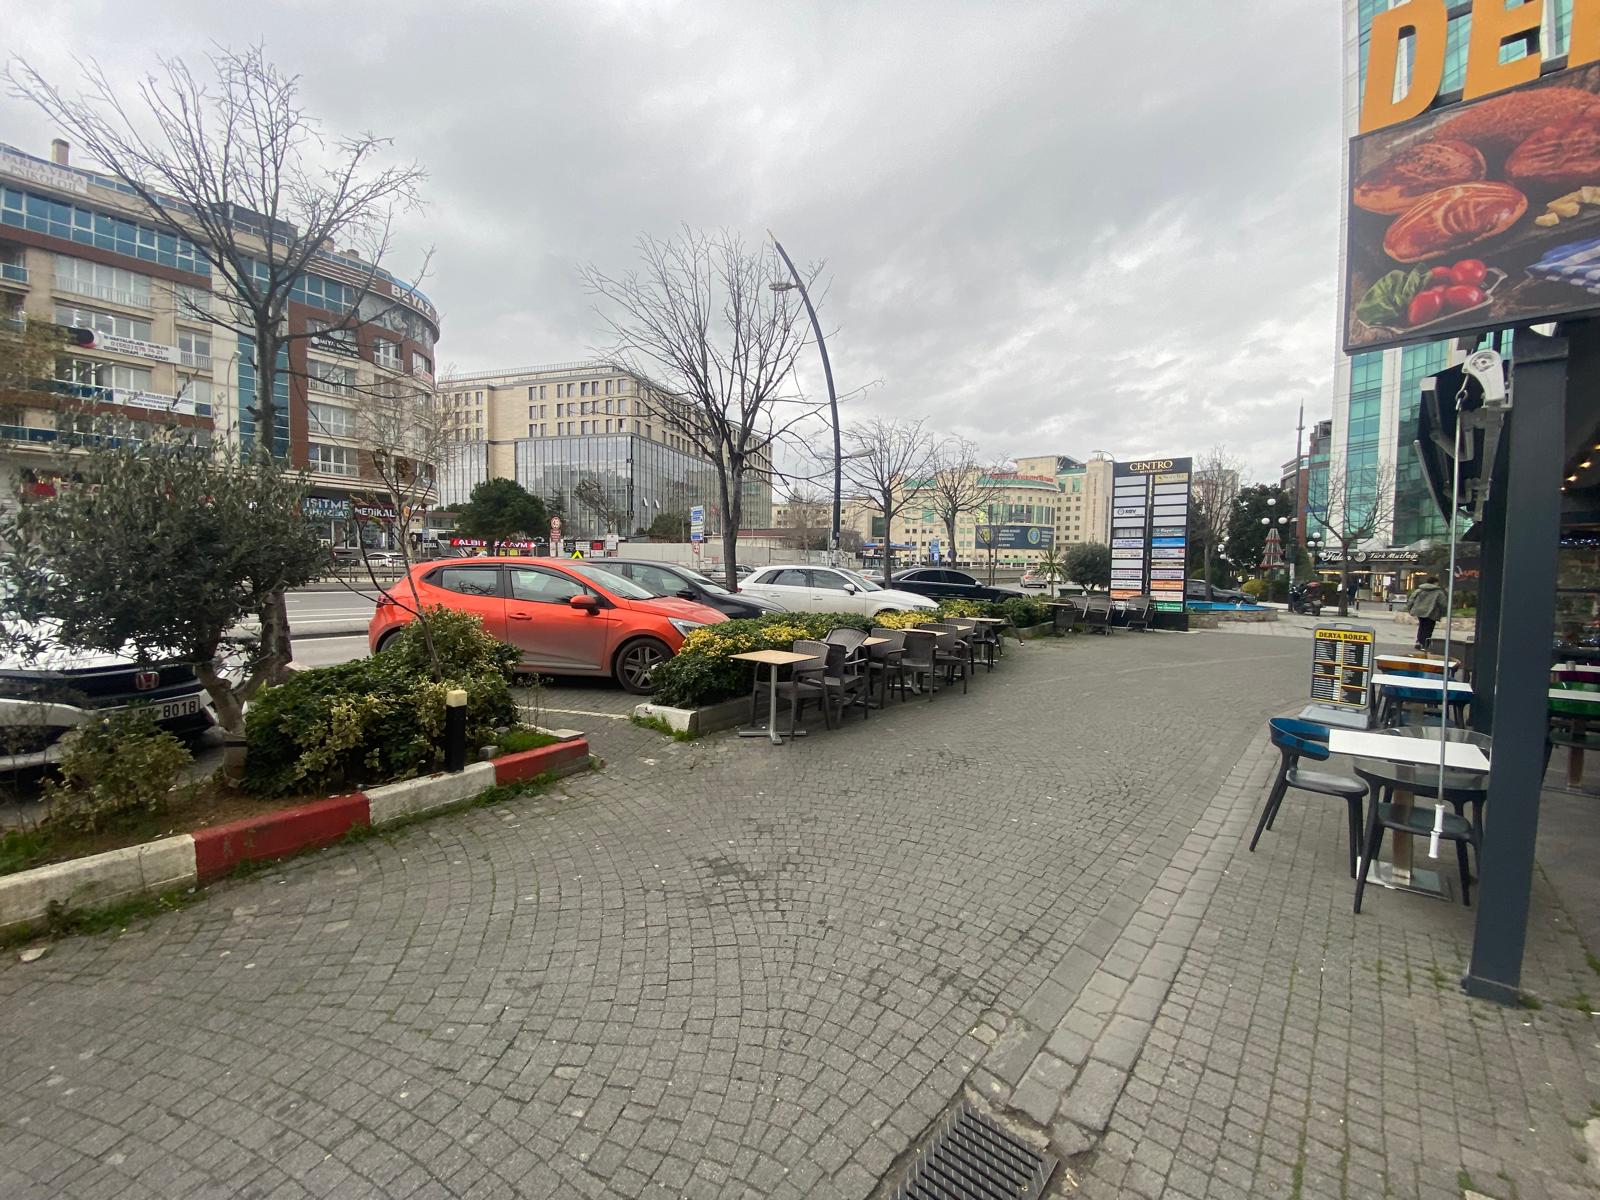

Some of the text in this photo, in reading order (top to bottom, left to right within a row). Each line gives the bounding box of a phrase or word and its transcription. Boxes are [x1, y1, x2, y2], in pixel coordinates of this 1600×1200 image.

[391, 284, 432, 316] BEYAZ
[1130, 460, 1173, 471] CENTRO
[354, 507, 396, 518] MEDİKAL
[1319, 631, 1342, 639] DERYA
[163, 701, 196, 718] 8018
